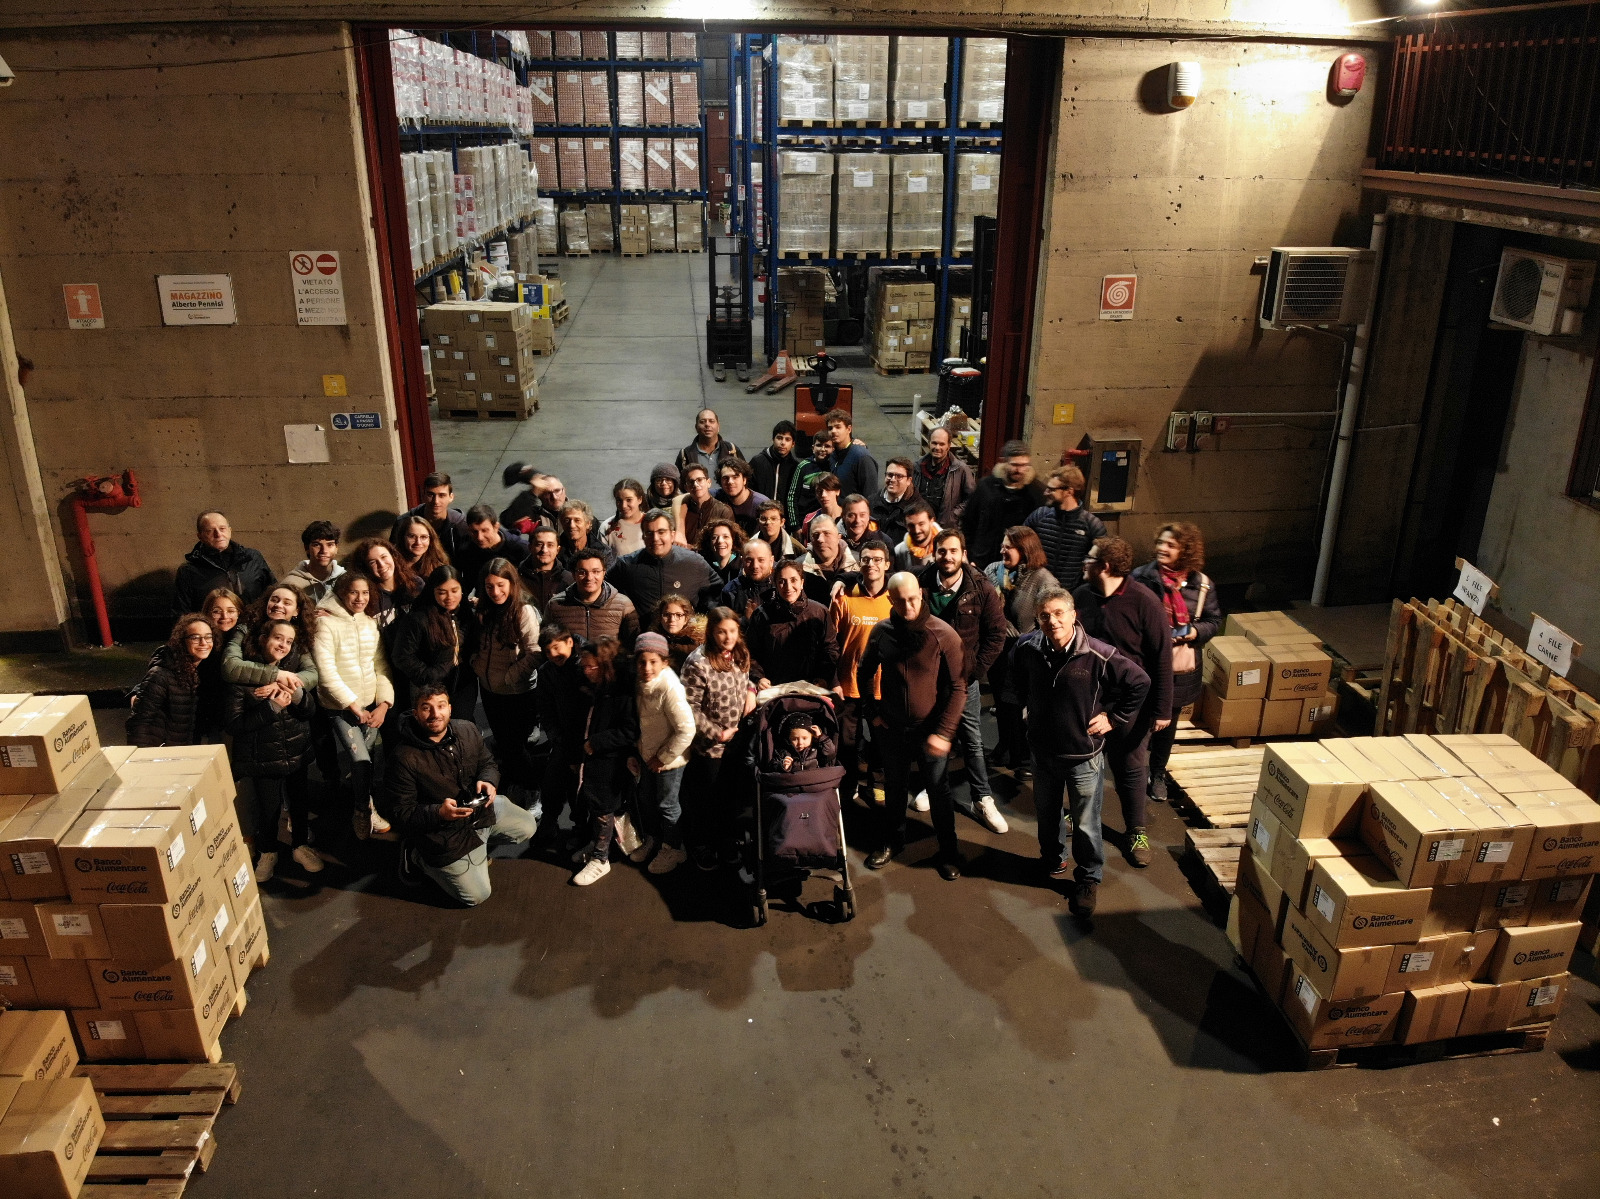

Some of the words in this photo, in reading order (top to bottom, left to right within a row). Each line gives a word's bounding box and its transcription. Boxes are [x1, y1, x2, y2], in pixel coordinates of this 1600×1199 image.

[170, 291, 223, 300] MAGAZZINO
[198, 300, 224, 308] Pennisi
[1472, 580, 1483, 592] FILE
[1548, 638, 1563, 651] FILE
[1537, 644, 1558, 662] CARNE
[1293, 682, 1319, 692] Coca-Cola
[62, 724, 76, 738] Banco
[64, 720, 88, 746] Alimentare
[72, 736, 92, 764] Coca-Cola
[1276, 768, 1290, 784] Banco
[1275, 776, 1299, 800] Alimentare
[1274, 794, 1295, 818] Coca-Cola
[1381, 812, 1396, 830] Banco
[212, 828, 224, 844] Banco
[214, 822, 234, 850] Alimentare
[1380, 819, 1408, 850] Alimentare
[1560, 836, 1583, 844] Banco
[1558, 840, 1600, 850] Alimentare
[94, 858, 122, 866] Banco
[1556, 856, 1594, 871] Coca-Cola
[106, 880, 150, 894] Coca-Cola
[179, 884, 192, 902] Banco
[182, 876, 202, 910] Alimentare
[1368, 918, 1414, 928] Alimentare
[1370, 914, 1395, 922] Banco
[1526, 951, 1564, 963] Alimentare
[1528, 948, 1550, 957] Banco
[122, 975, 172, 983] Alimentare
[133, 989, 175, 1002] Coca-Cola
[208, 983, 219, 1002] Banco
[210, 975, 228, 1010] Alimentare
[1344, 1010, 1388, 1019] Alimentare
[1345, 1023, 1382, 1036] Coca-Cola
[42, 1046, 55, 1065] Banco
[44, 1036, 66, 1074] Alimentare
[71, 1116, 82, 1139] Banco
[74, 1105, 92, 1146] Alimentare
